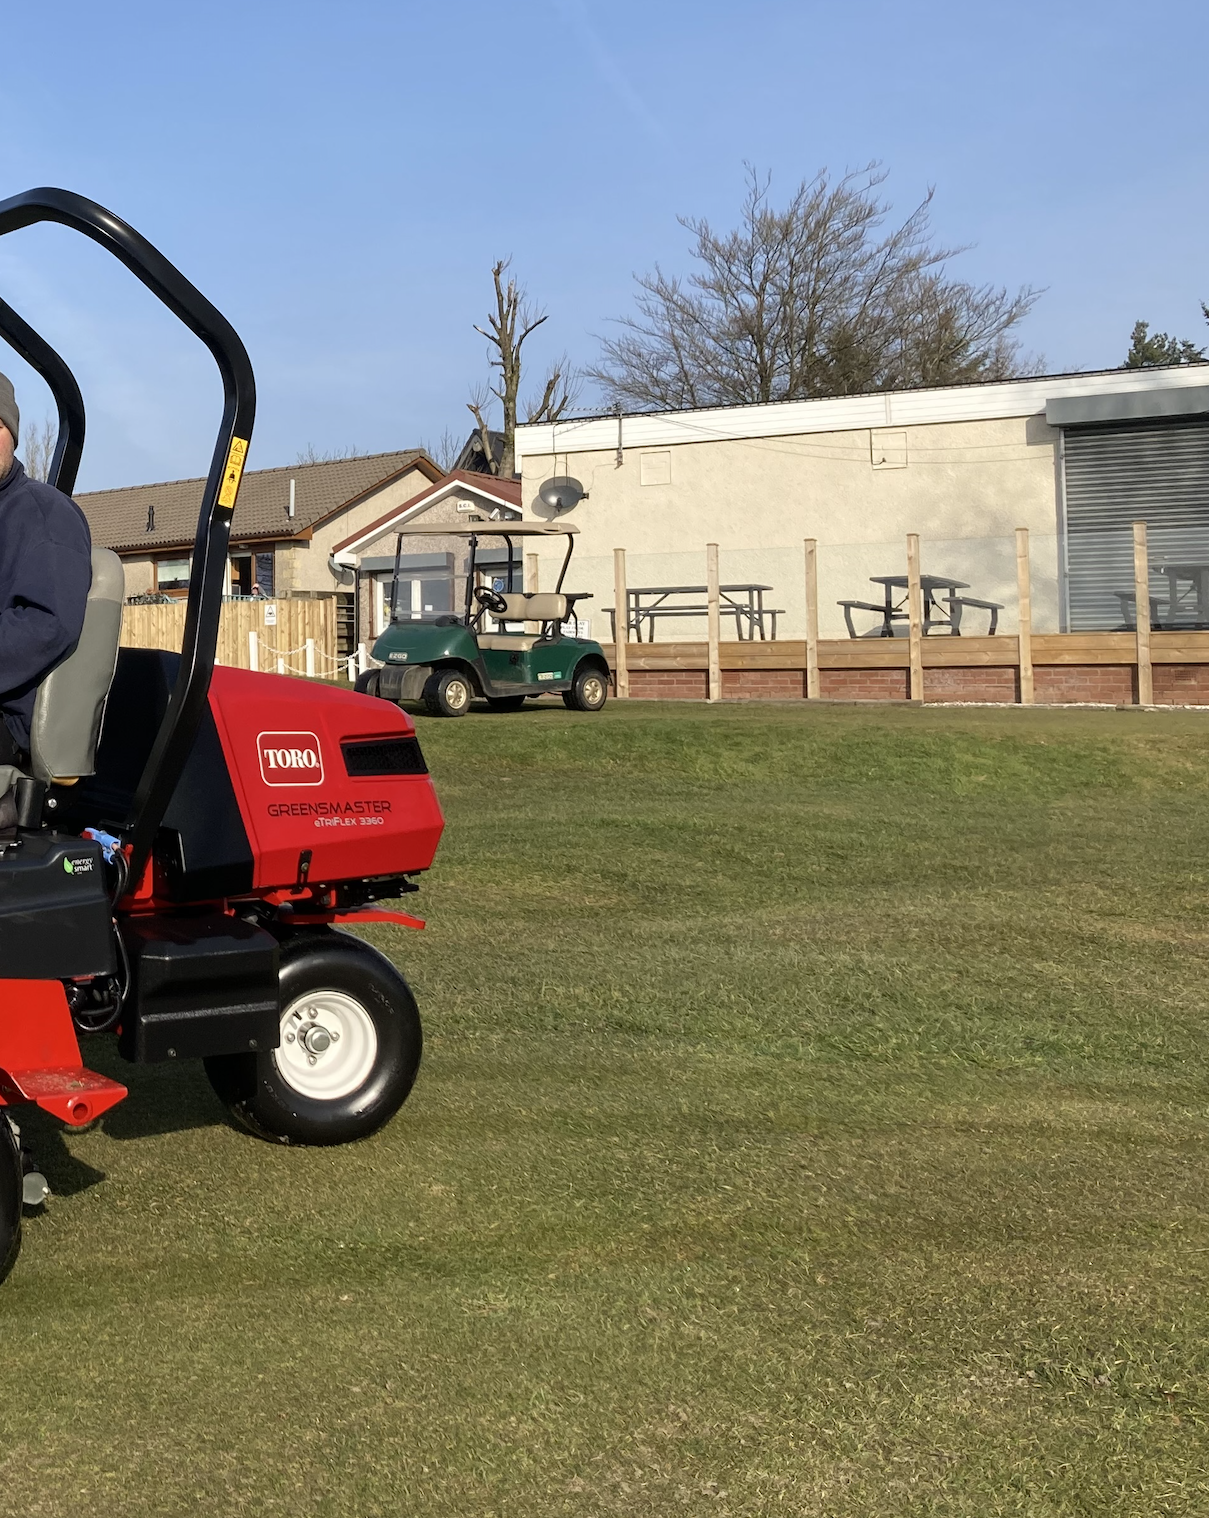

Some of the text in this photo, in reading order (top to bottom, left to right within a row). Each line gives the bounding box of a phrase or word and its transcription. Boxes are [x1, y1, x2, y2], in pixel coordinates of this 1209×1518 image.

[263, 749, 317, 769] TORO
[267, 800, 392, 817] GREENSMASTER
[359, 816, 384, 826] 3360
[74, 864, 93, 872] smart
